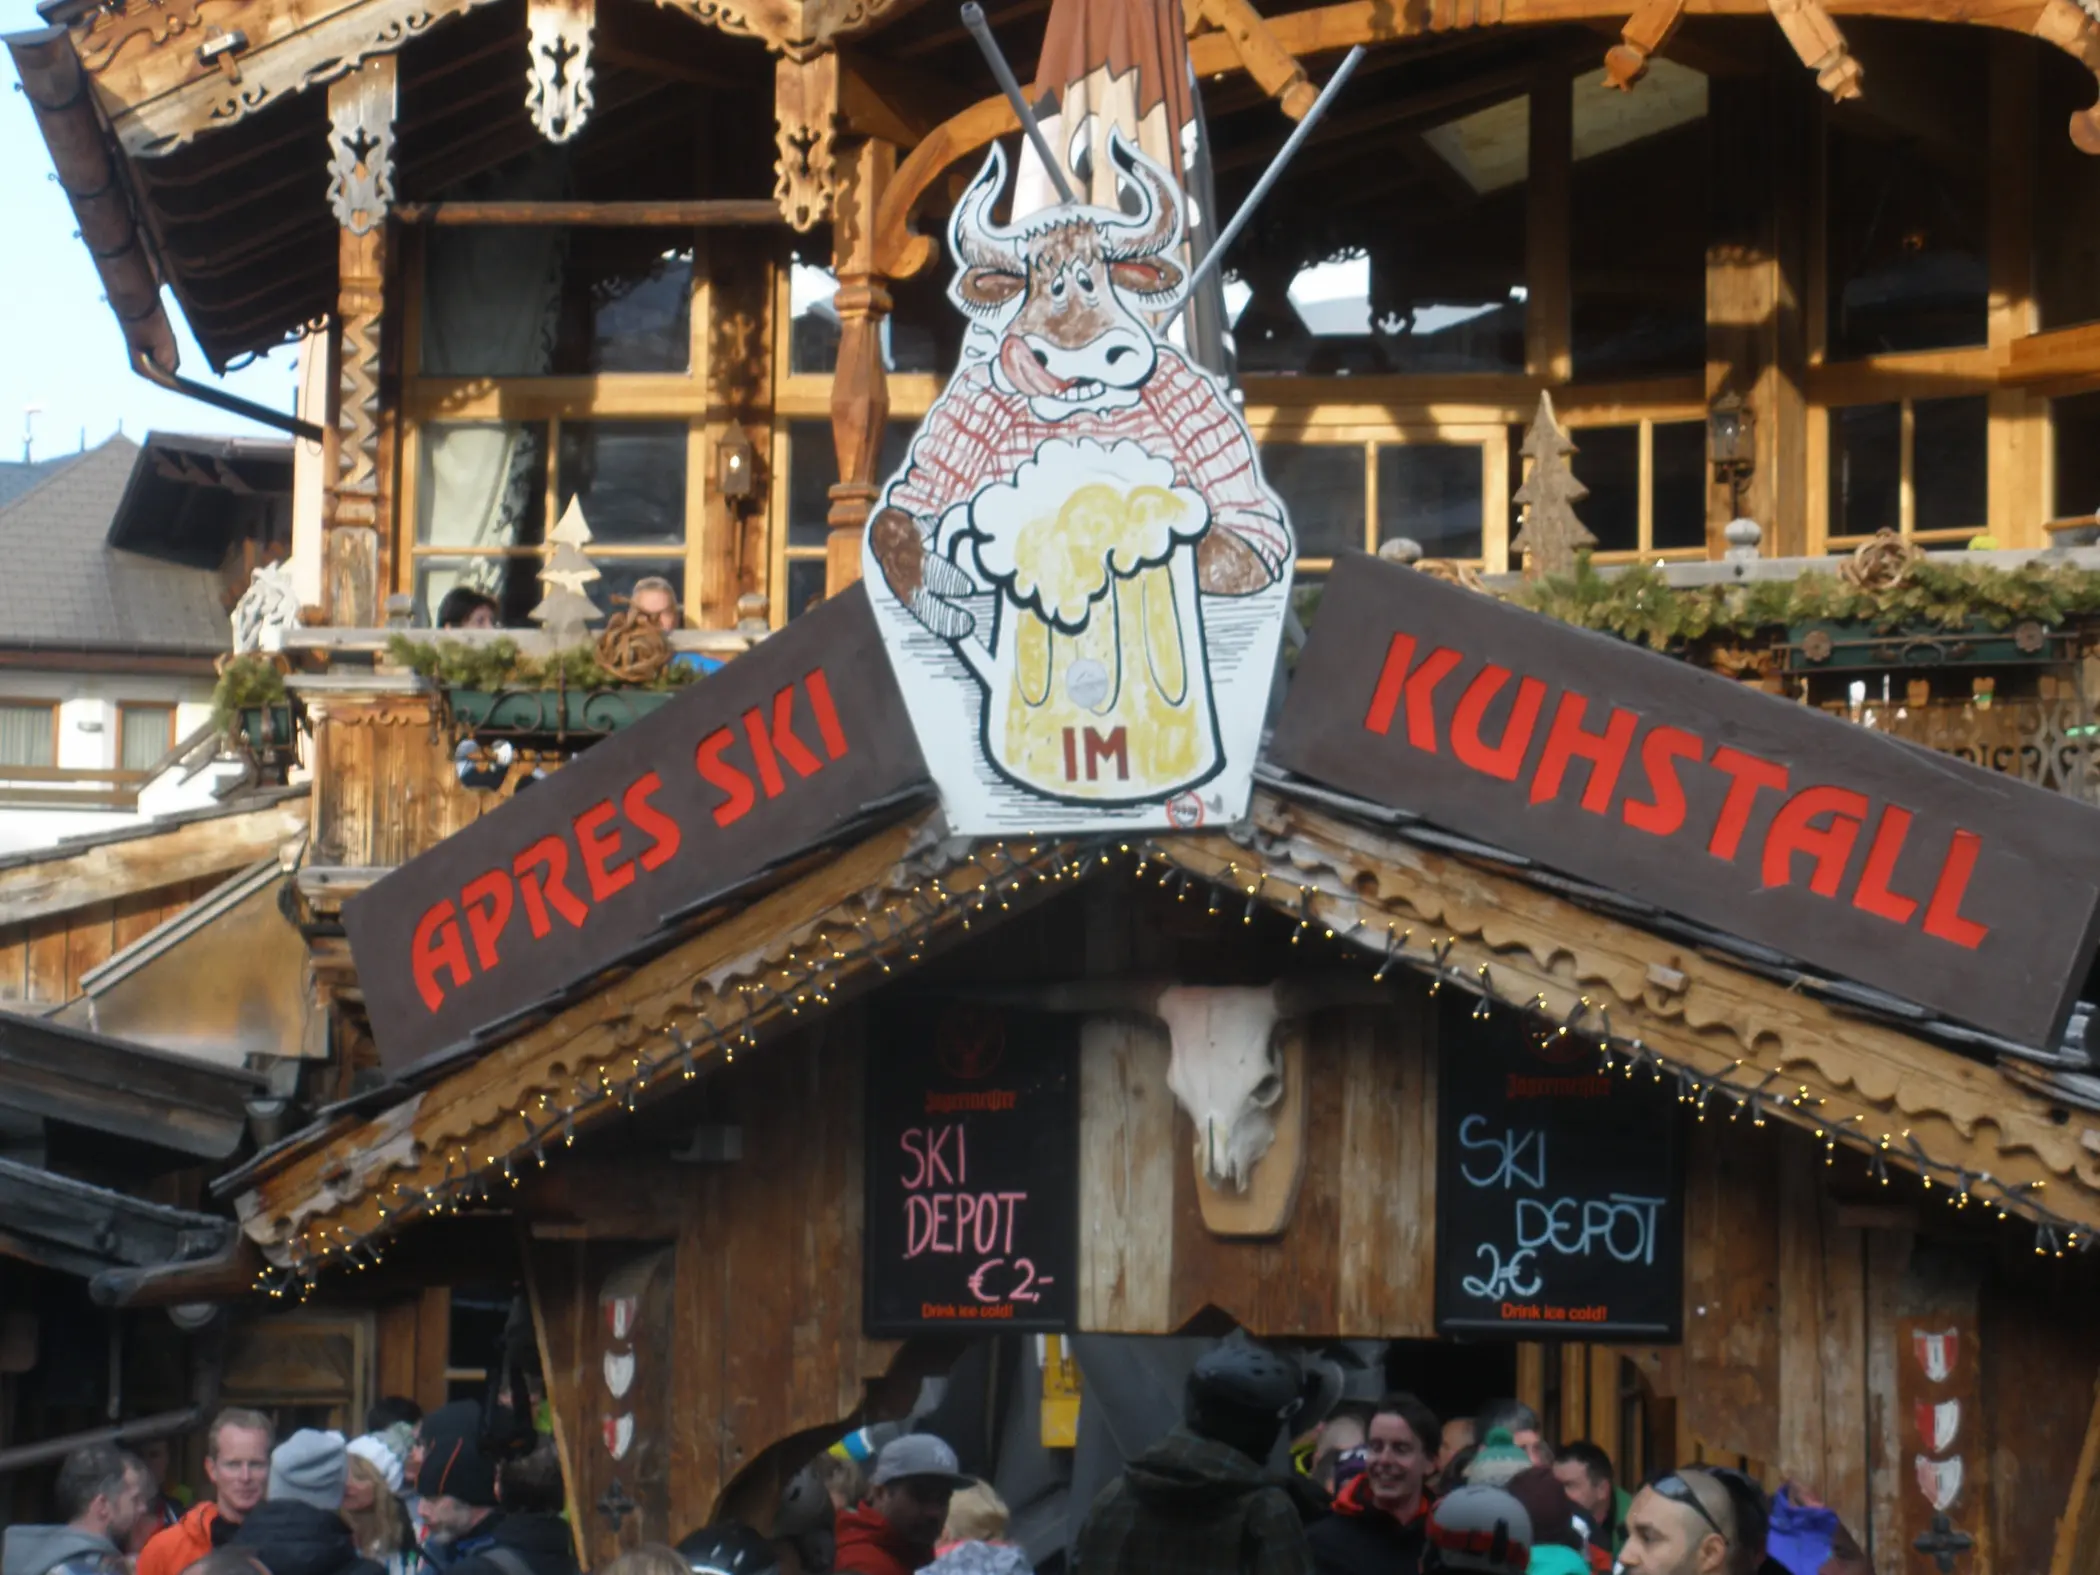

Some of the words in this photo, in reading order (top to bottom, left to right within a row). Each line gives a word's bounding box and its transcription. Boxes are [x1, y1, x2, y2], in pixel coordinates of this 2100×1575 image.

[1062, 725, 1130, 782] IM
[1365, 632, 1988, 948] KUHSTALL
[410, 770, 683, 1014] APRES
[695, 668, 848, 829] SKI
[900, 1124, 966, 1189] SKI
[1460, 1114, 1545, 1190] SKI
[901, 1191, 1028, 1260] DEPOT
[1516, 1193, 1666, 1266] DEPOT
[1502, 1302, 1541, 1320] Drink
[1543, 1304, 1566, 1320] ice
[1568, 1305, 1608, 1322] cold!
